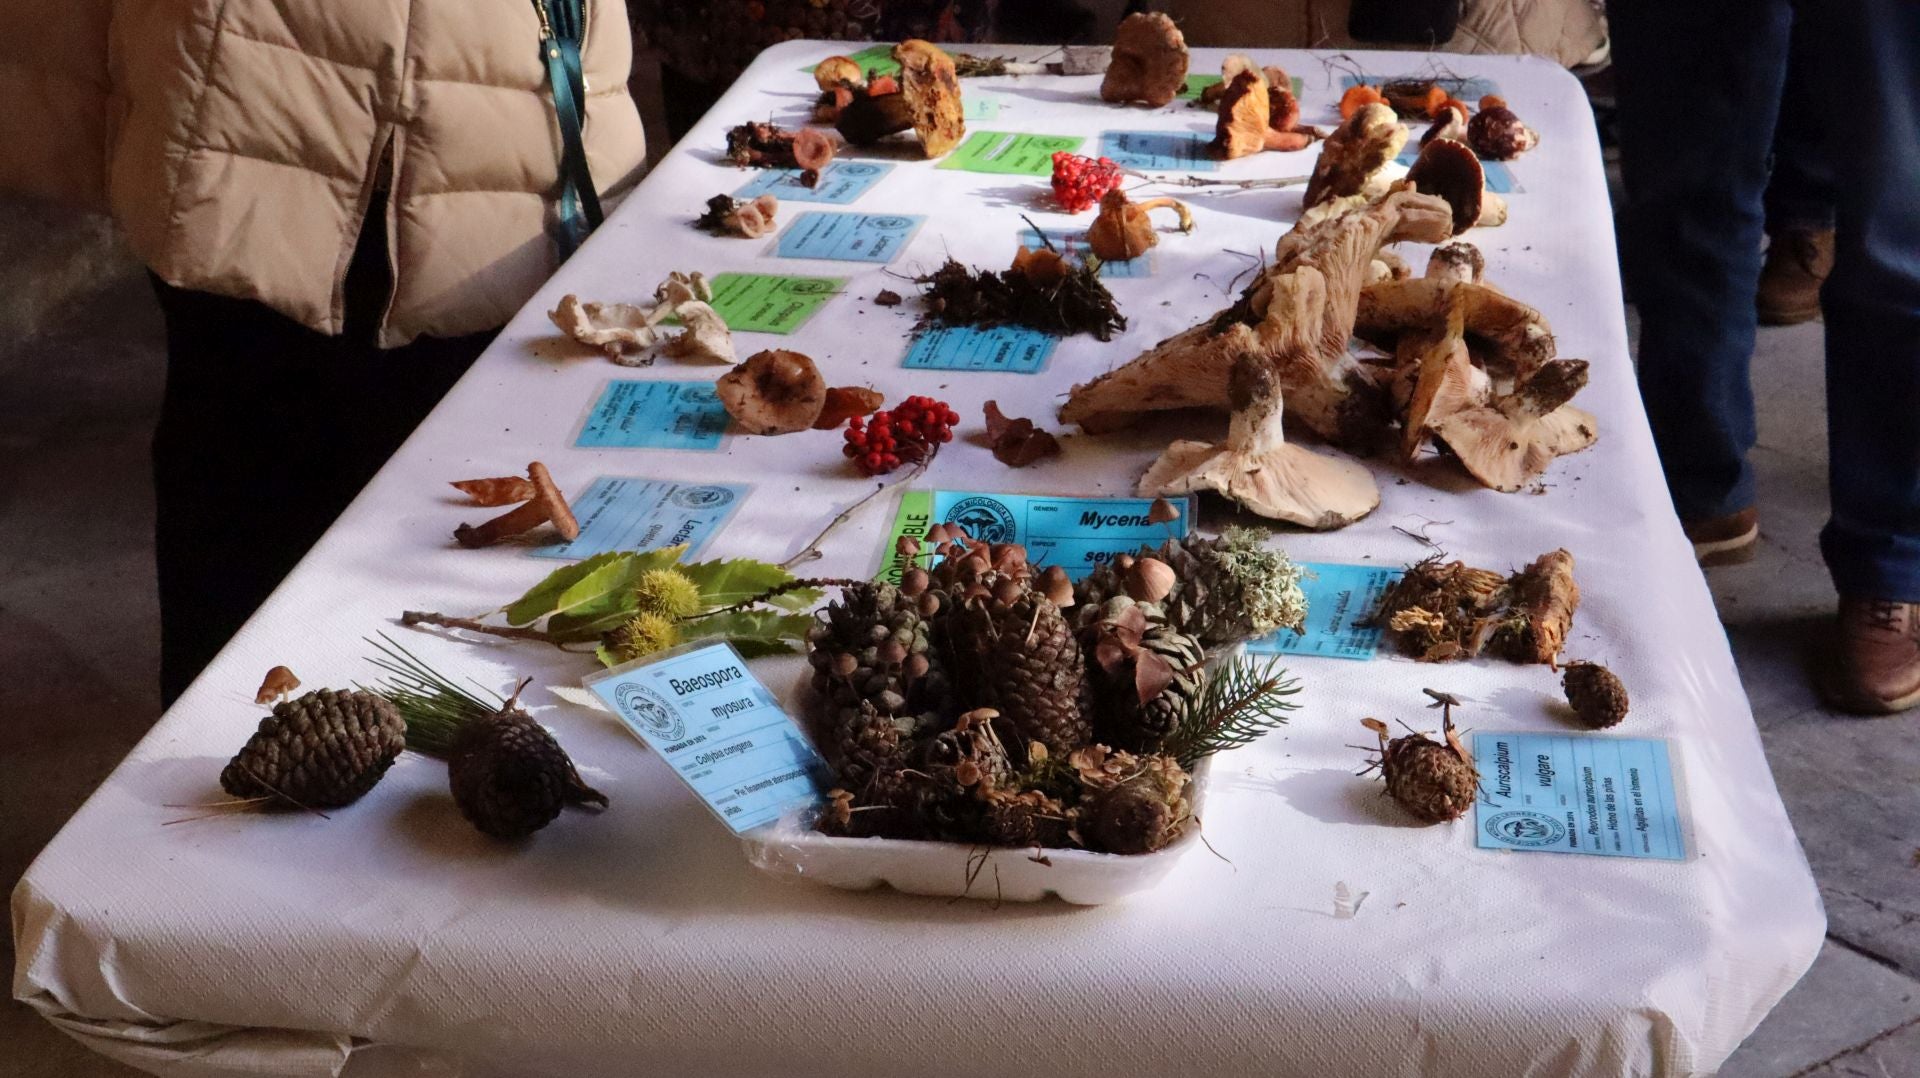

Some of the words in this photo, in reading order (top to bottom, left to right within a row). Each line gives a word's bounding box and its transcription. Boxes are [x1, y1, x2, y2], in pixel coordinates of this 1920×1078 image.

[1080, 511, 1150, 530] Mycena
[669, 519, 702, 548] Lactar
[669, 665, 743, 696] Baeospora
[710, 696, 755, 720] myosura
[695, 748, 728, 765] Collybia
[1495, 741, 1512, 799] Auriscalpium
[1535, 754, 1556, 787] vulgare
[1583, 766, 1597, 804] auriscalpium
[1602, 777, 1616, 793] piñas
[1603, 793, 1615, 802] las
[1604, 803, 1616, 811] de
[1606, 812, 1618, 830] Hidno
[1634, 806, 1650, 831] Agujitas
